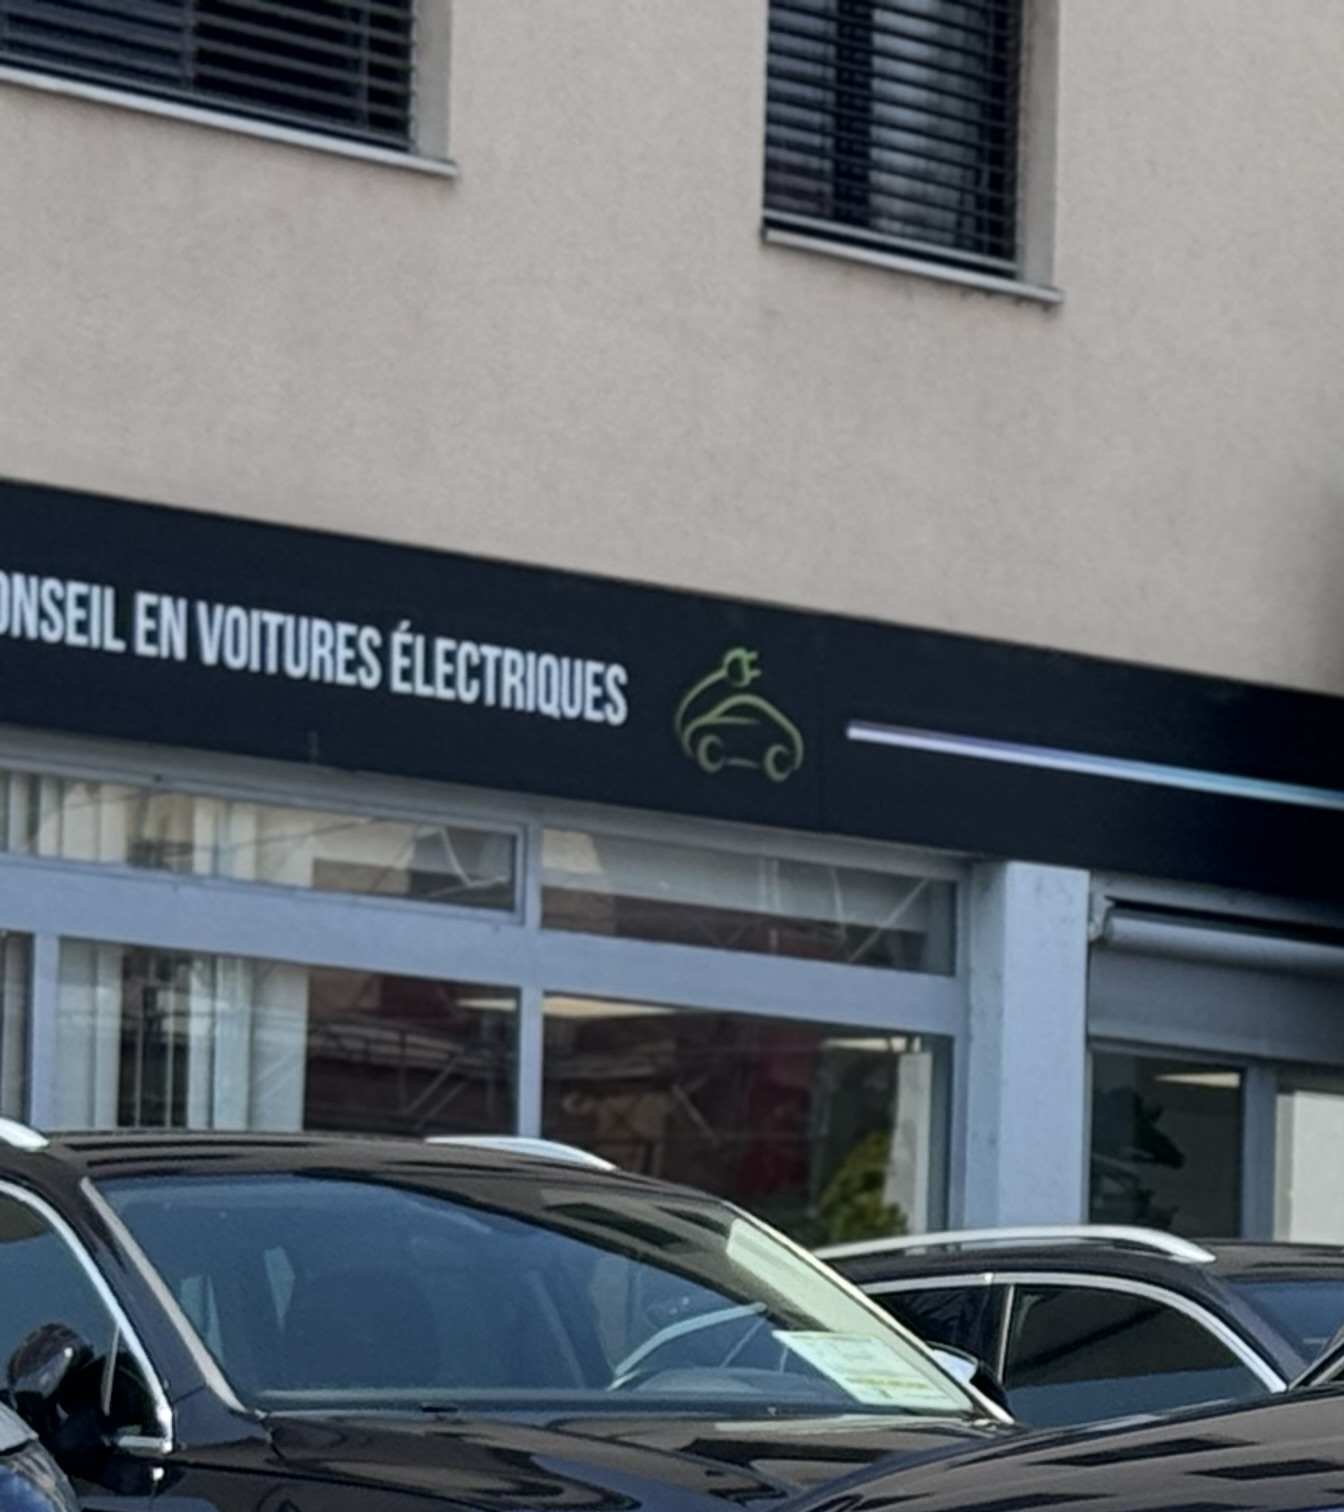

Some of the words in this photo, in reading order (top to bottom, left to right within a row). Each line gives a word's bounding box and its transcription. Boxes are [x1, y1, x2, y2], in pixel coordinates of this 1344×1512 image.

[134, 589, 188, 662] EN
[196, 600, 383, 690] VOITURES
[390, 618, 629, 727] ÉLECTRIQUES
